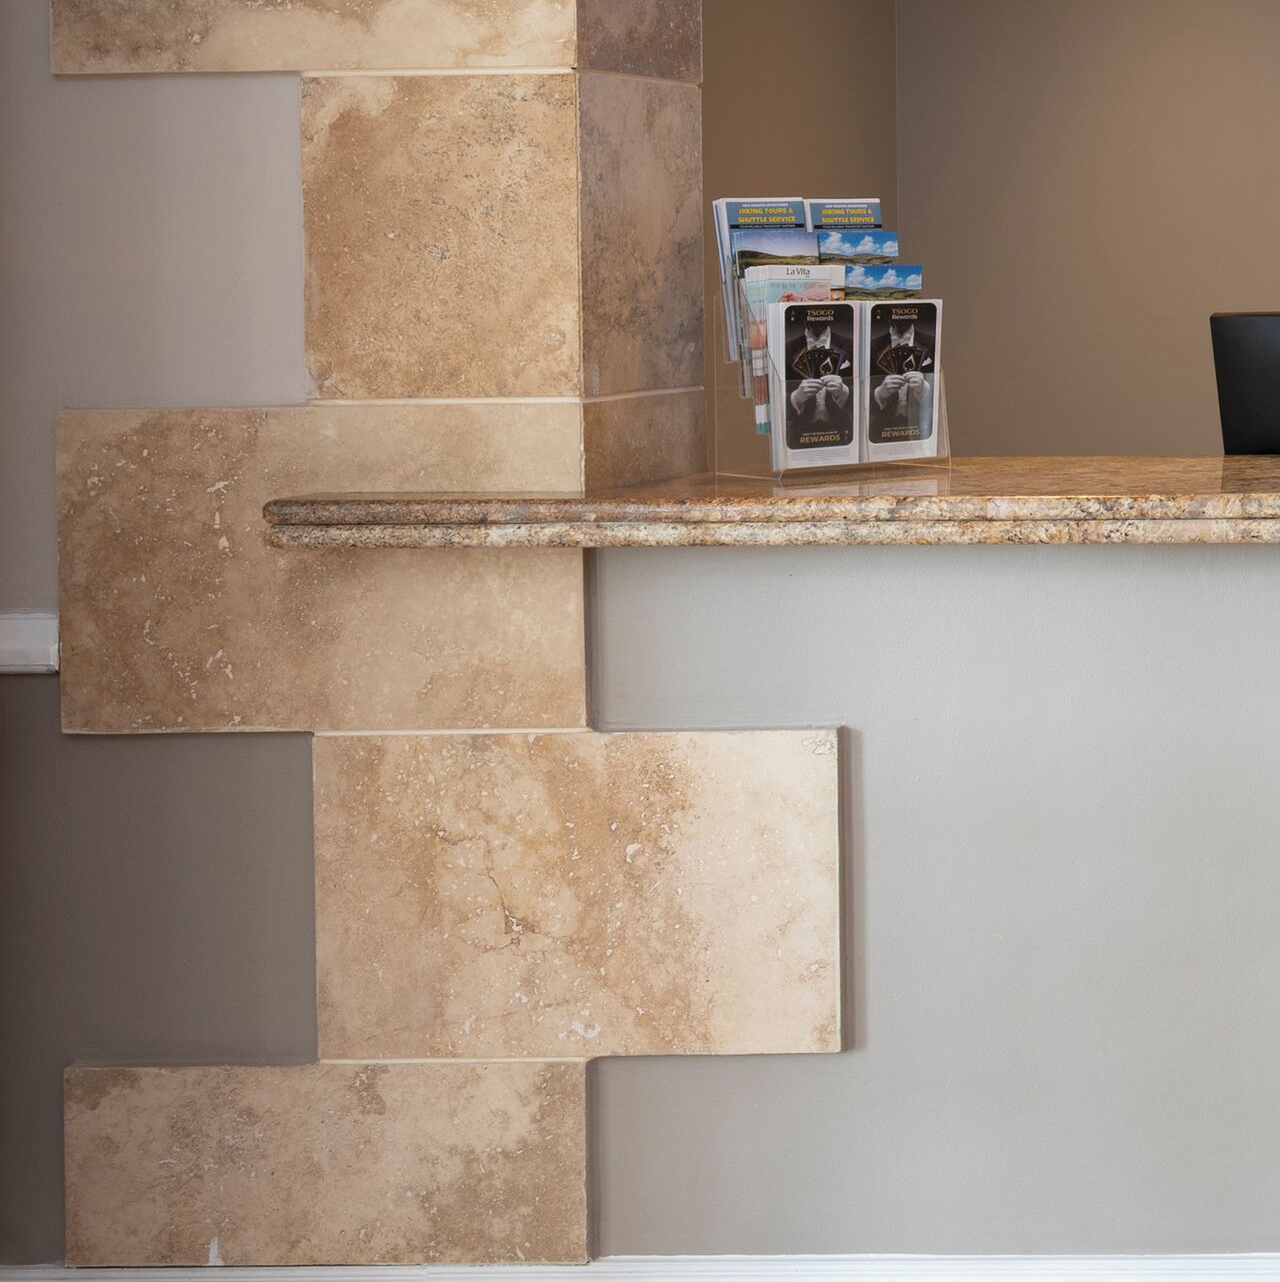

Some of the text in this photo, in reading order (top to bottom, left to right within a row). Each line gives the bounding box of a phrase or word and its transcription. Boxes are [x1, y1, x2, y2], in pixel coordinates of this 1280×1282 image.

[786, 267, 811, 276] La Vita
[799, 433, 841, 444] REWARDS
[881, 428, 921, 439] REWARDS
